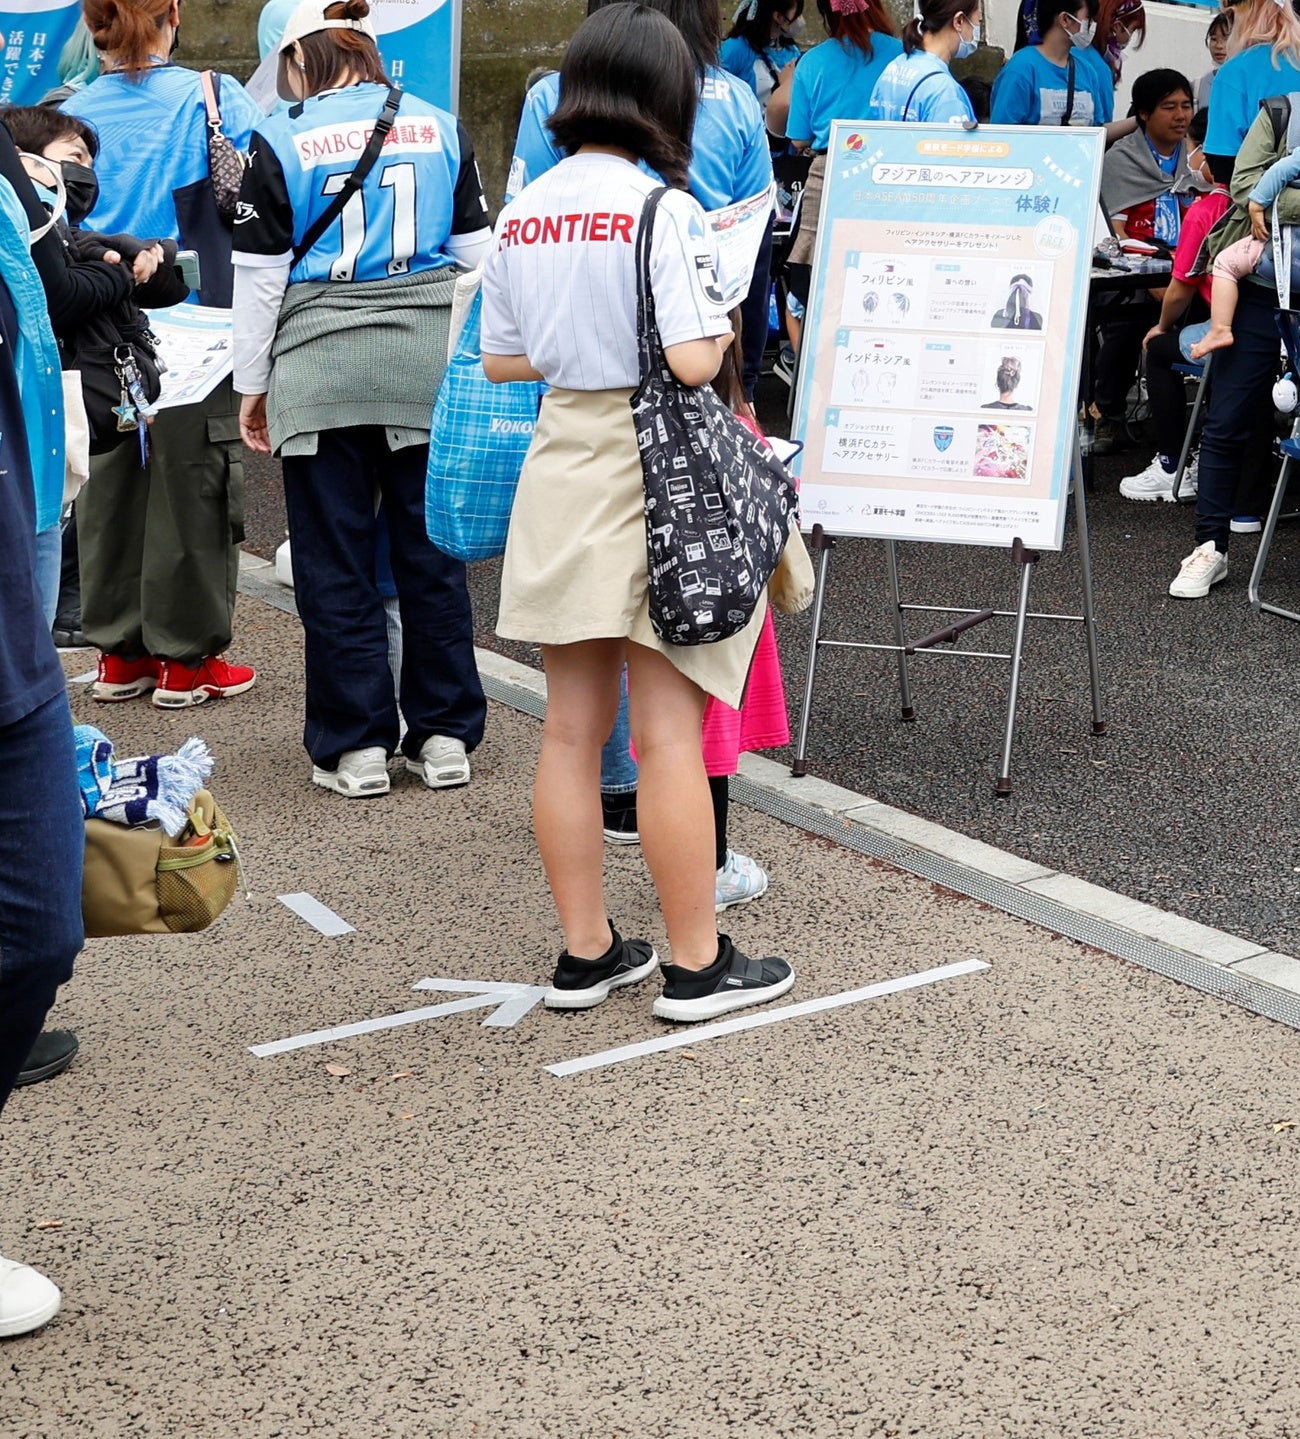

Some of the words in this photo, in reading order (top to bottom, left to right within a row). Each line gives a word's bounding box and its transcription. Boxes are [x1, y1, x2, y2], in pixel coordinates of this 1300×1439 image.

[26, 33, 47, 76] 日本で
[877, 168, 1028, 187] アジア風のヘアアレンジ
